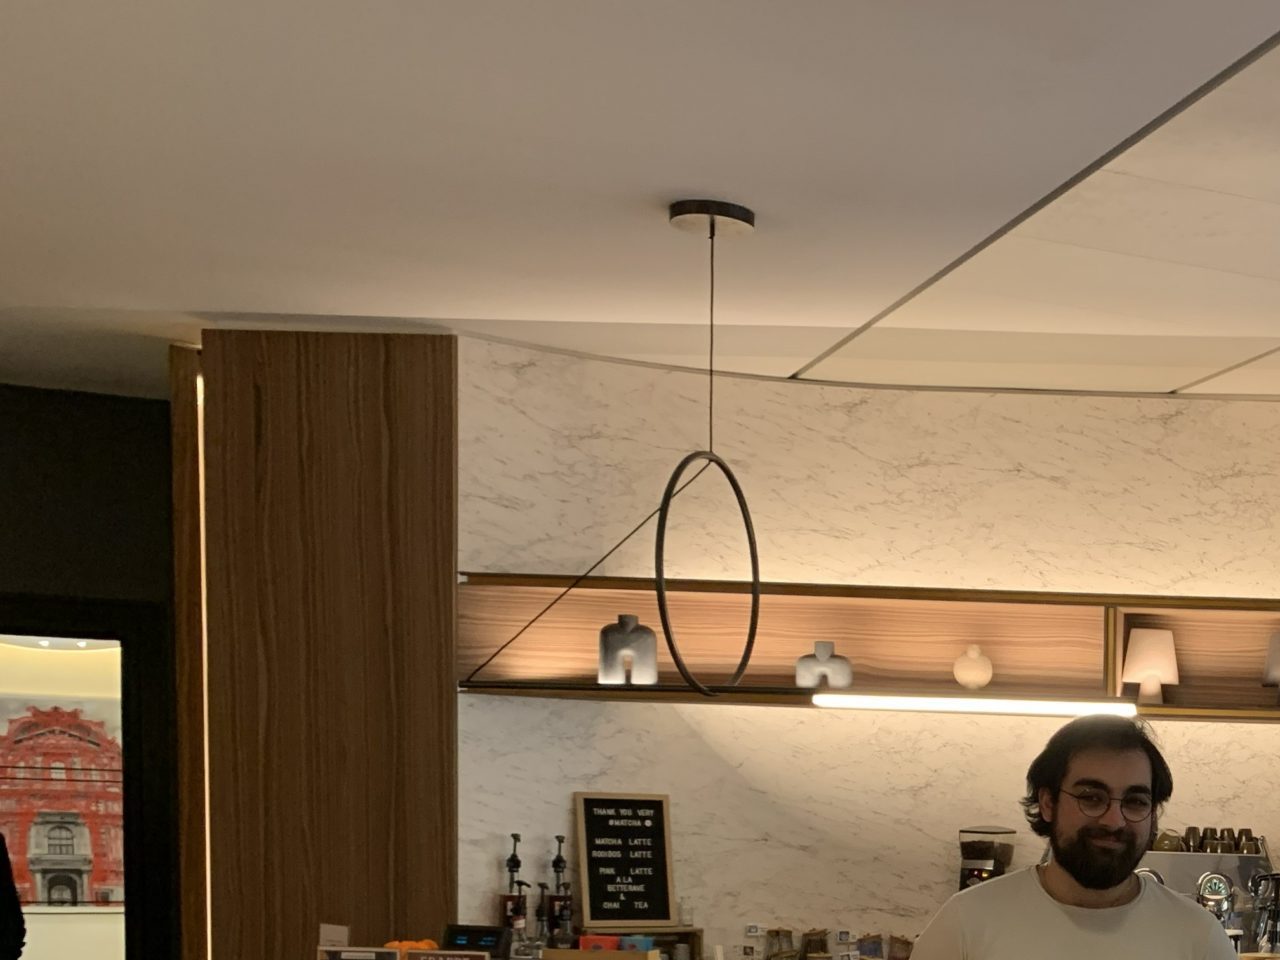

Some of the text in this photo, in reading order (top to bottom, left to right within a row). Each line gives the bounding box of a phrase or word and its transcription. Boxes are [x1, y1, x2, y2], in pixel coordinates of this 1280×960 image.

[593, 807, 654, 817] THANK YOU VERY
[629, 838, 652, 846] LATTE
[630, 850, 653, 858] LATTE
[630, 867, 653, 875] LATTE
[603, 901, 648, 909] CHAI TEA
